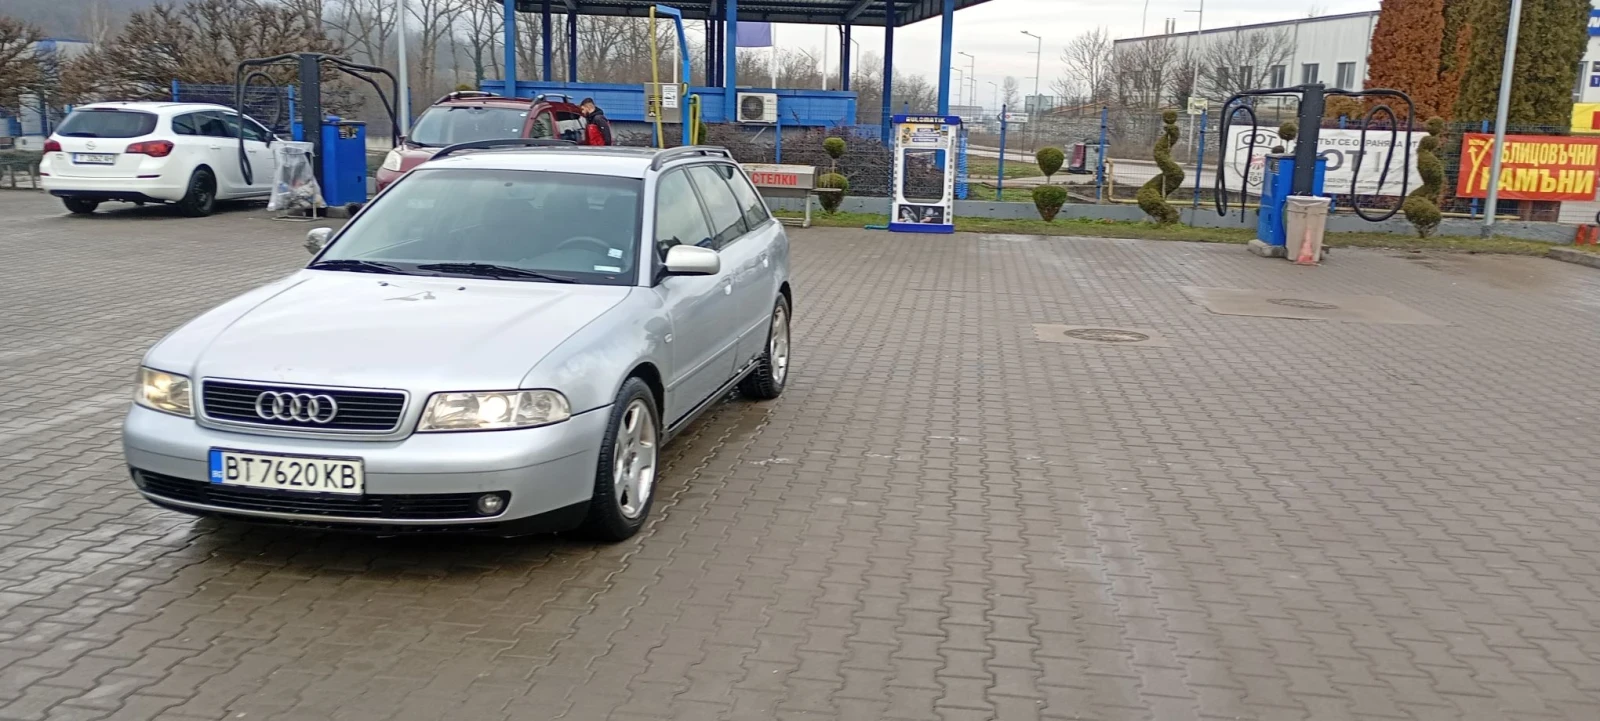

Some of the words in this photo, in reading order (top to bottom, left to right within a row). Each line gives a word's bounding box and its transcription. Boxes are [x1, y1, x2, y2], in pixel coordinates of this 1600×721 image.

[1337, 138, 1351, 146] СЕ
[1352, 139, 1403, 147] ОРАНЯА
[1500, 142, 1598, 167] БЛИЦОВЪЧНИ
[752, 172, 797, 186] СТЕЛКИ
[226, 456, 254, 482] BT
[260, 459, 318, 486] 7620
[323, 464, 357, 489] KB
